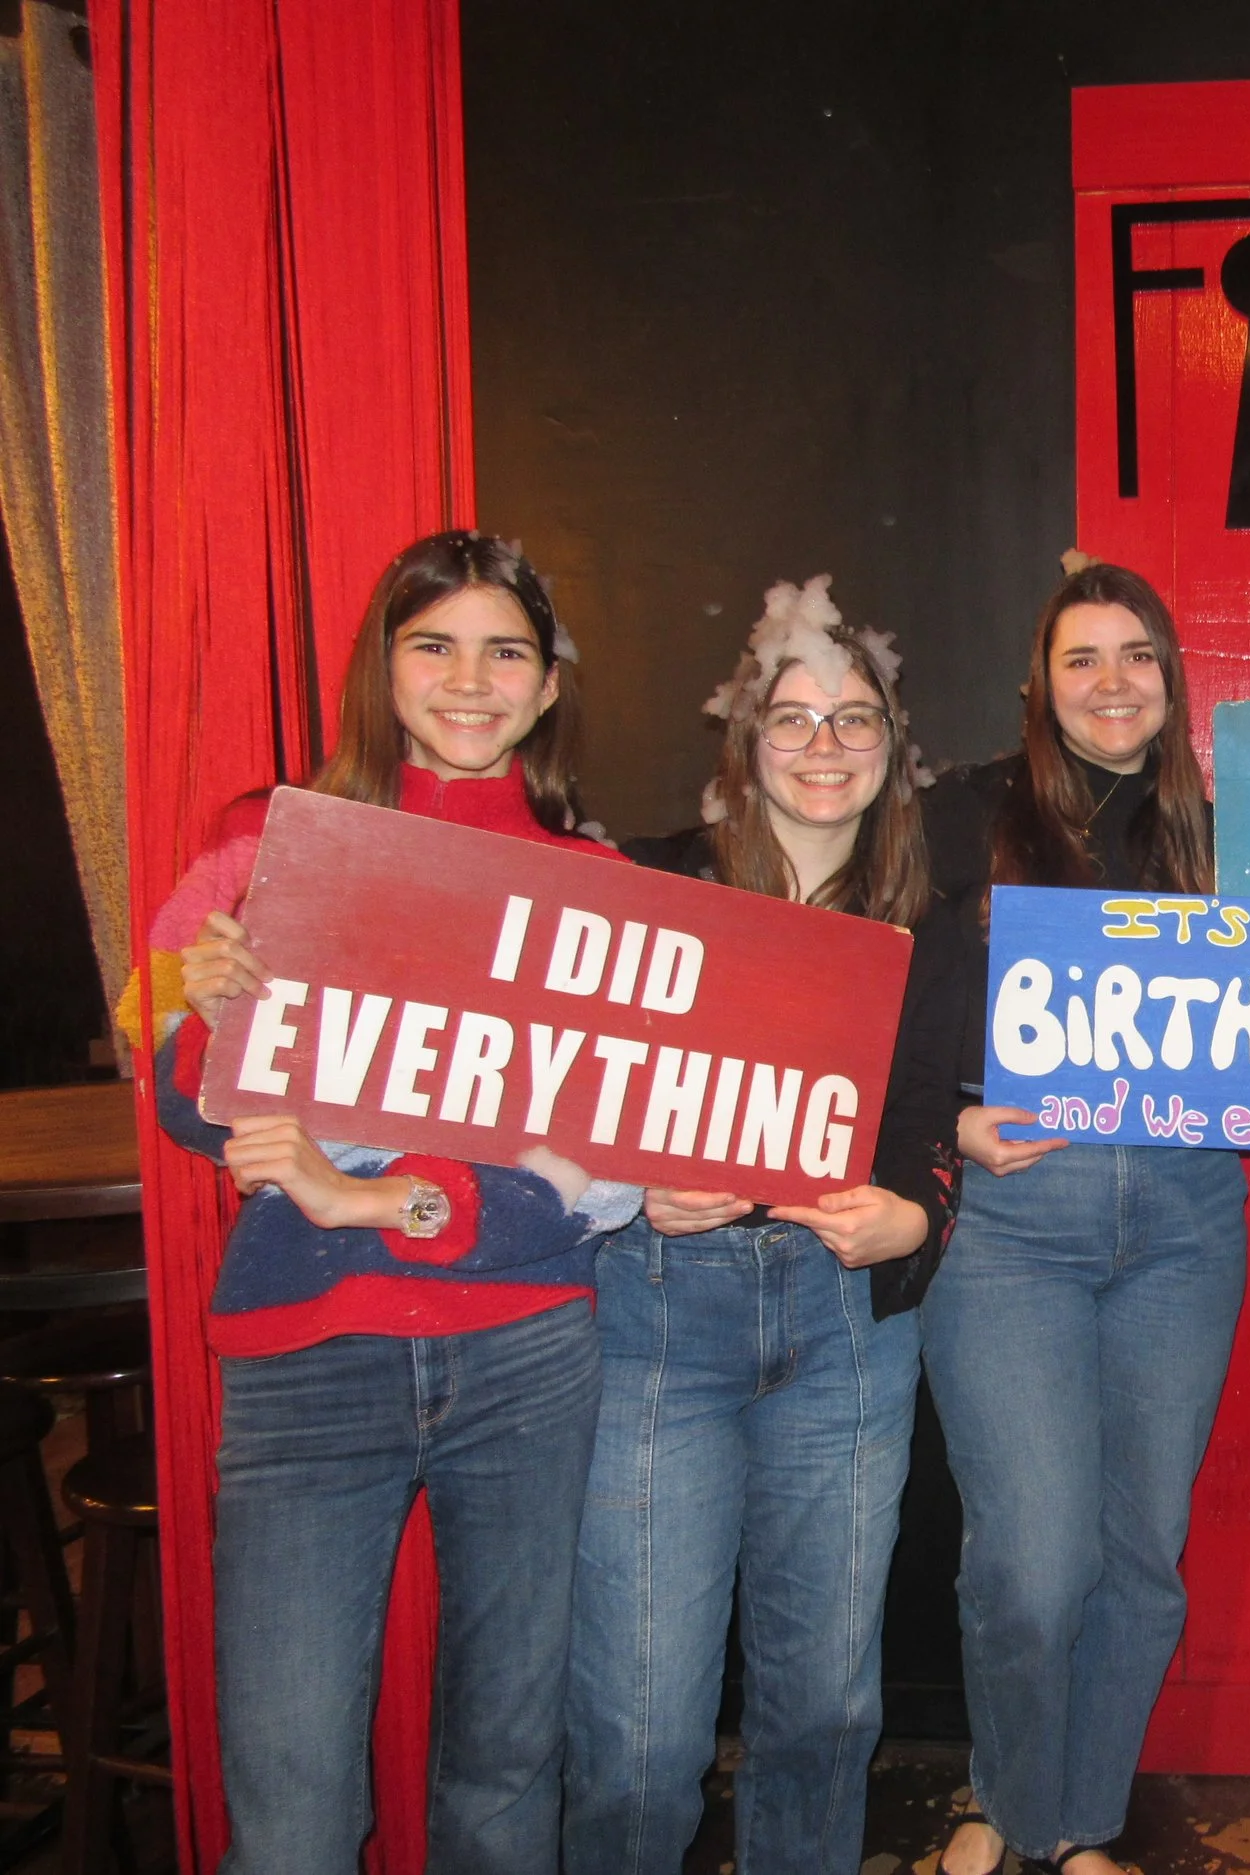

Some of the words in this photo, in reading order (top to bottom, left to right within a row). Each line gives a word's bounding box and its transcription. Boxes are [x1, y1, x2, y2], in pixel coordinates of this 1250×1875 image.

[490, 895, 534, 983] I
[544, 906, 705, 1016] DID
[1101, 898, 1250, 947] IT'S
[237, 977, 860, 1181] EVERYTHING
[1038, 1078, 1130, 1136] and
